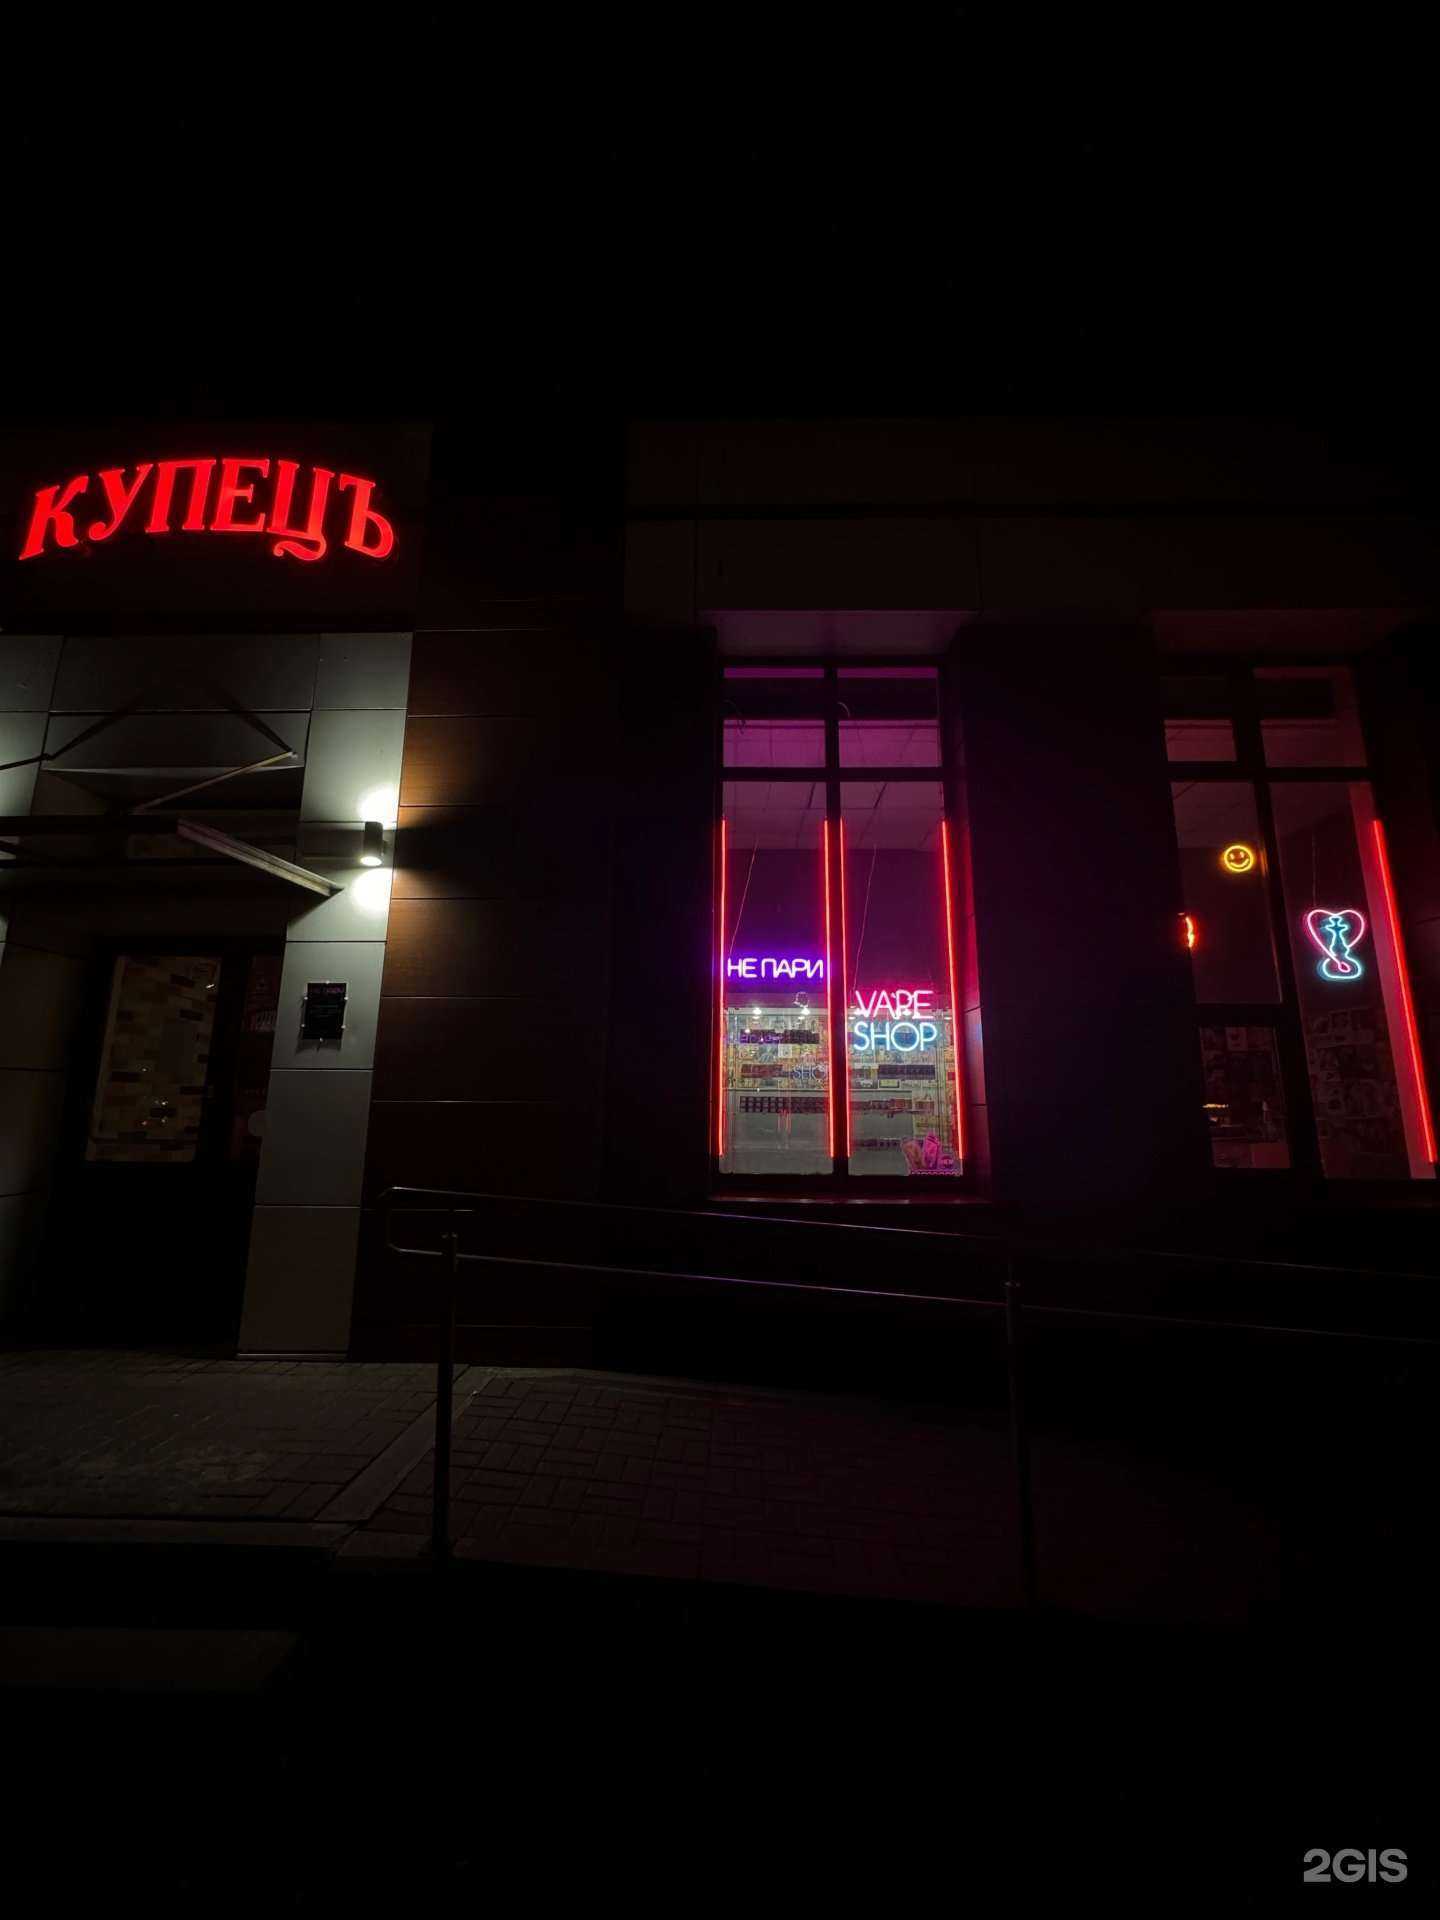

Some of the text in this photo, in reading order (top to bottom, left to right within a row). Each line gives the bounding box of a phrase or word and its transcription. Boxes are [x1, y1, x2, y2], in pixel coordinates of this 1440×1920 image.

[19, 458, 395, 561] КУПЕЦЪ
[727, 958, 824, 978] НЕ ПАРИ
[855, 990, 934, 1019] VAPE
[853, 1022, 937, 1052] SHOP
